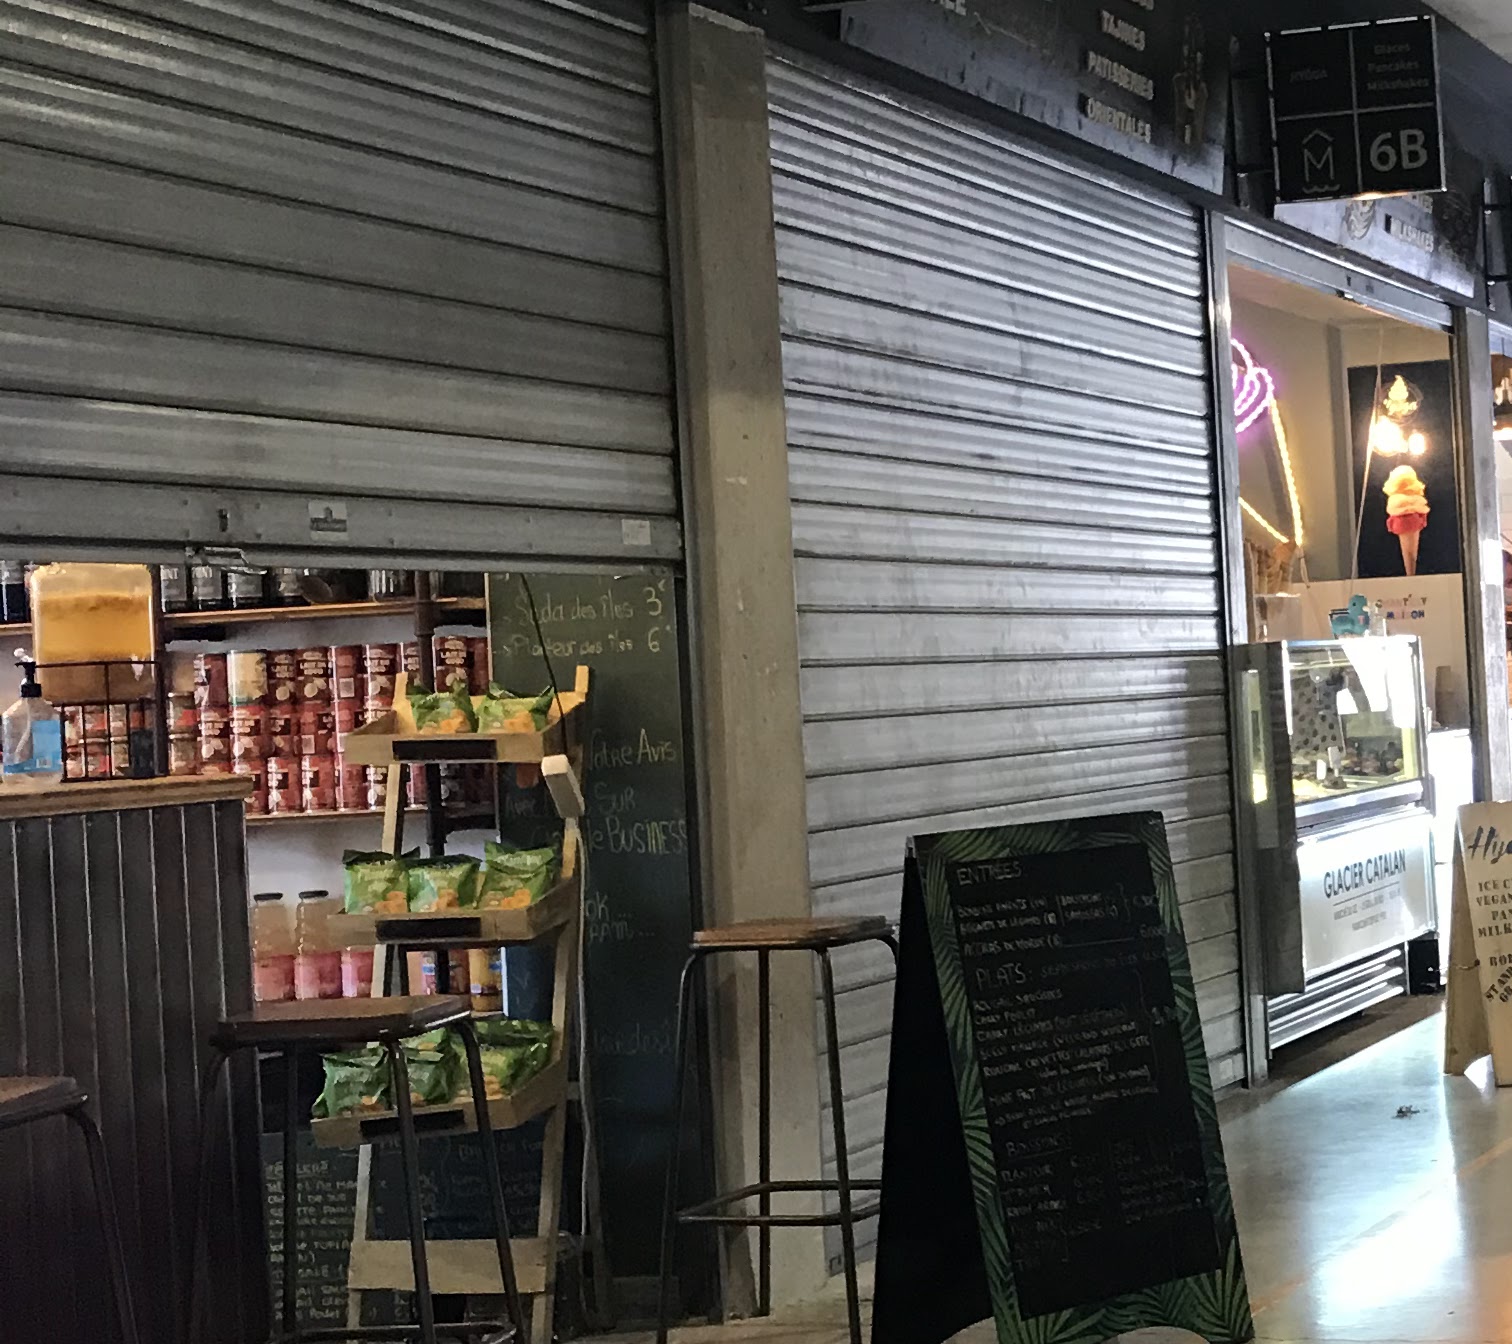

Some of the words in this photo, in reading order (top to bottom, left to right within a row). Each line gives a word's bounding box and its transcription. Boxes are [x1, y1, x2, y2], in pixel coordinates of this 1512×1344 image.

[1101, 9, 1145, 51] TAJINES
[1087, 96, 1151, 144] ORIENTALES
[1369, 128, 1428, 173] 6B
[1324, 861, 1365, 899] GLACIER
[1366, 849, 1406, 884] CATALAN
[1478, 879, 1499, 892] ICE
[1478, 923, 1512, 938] MILK
